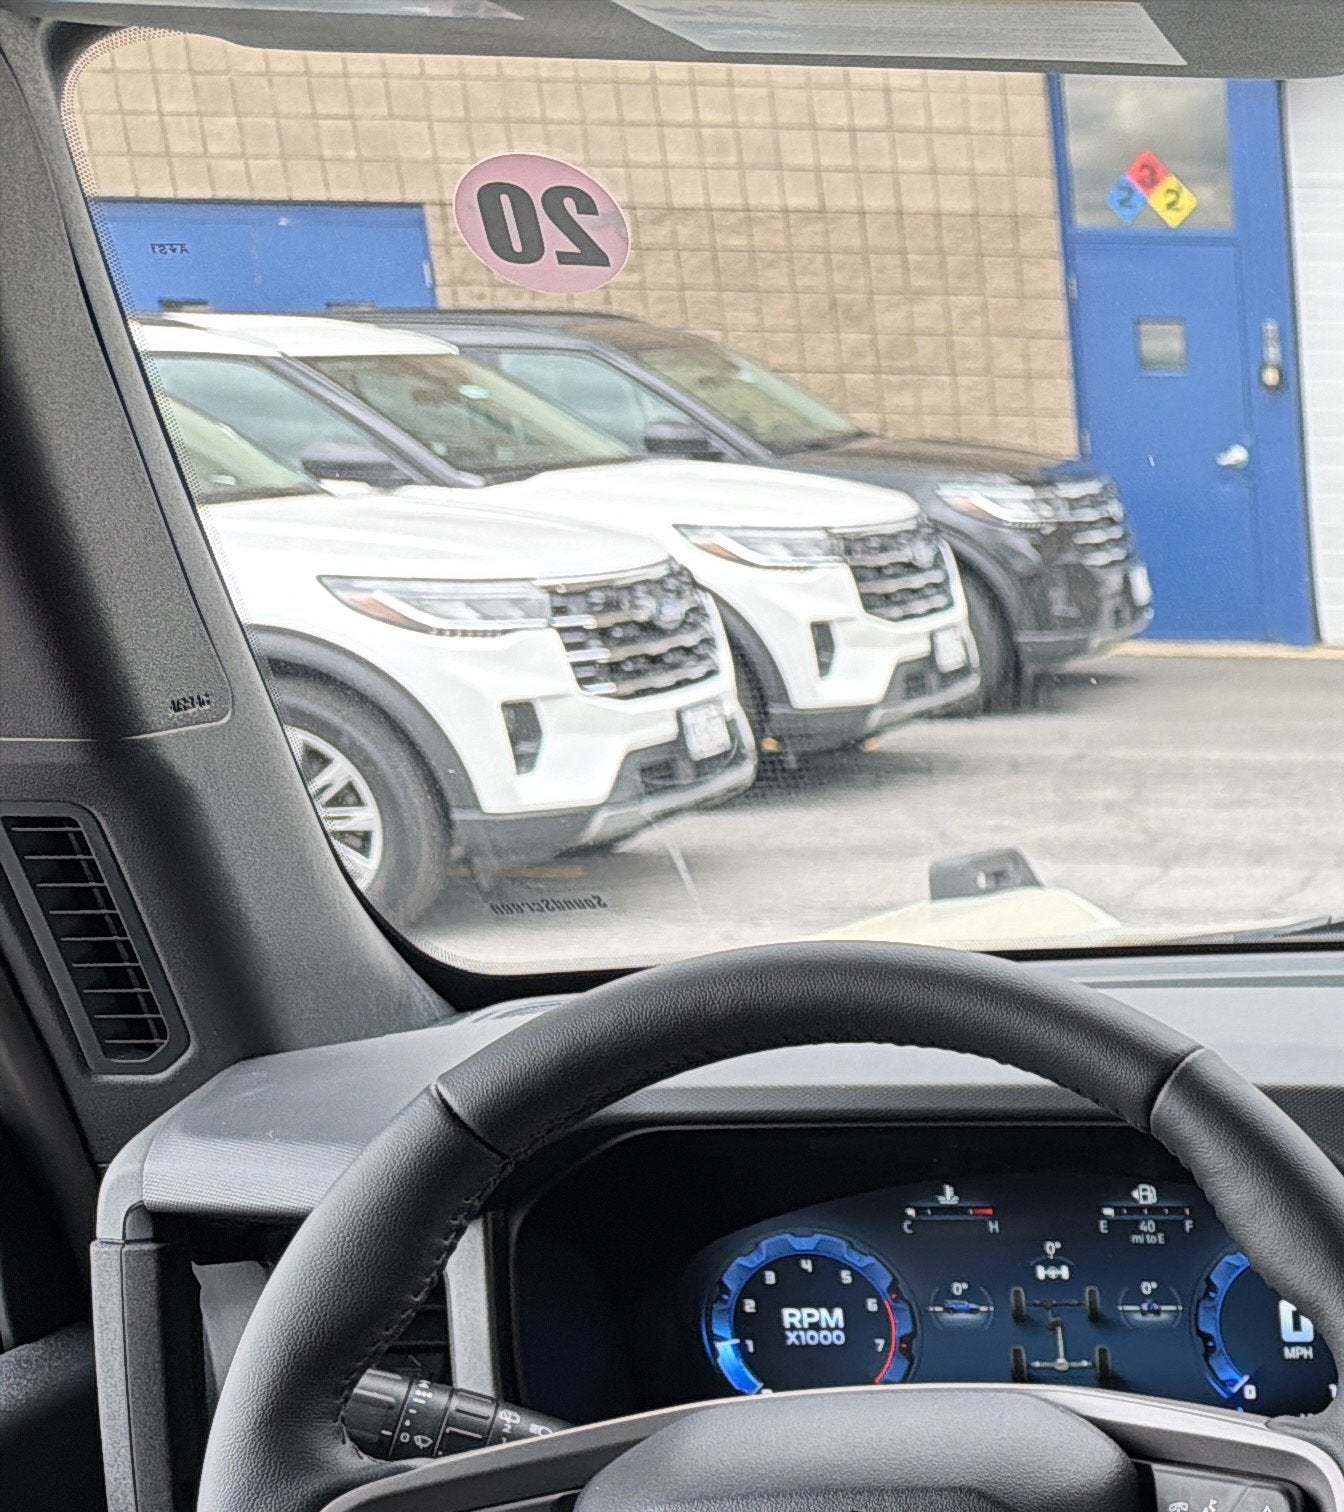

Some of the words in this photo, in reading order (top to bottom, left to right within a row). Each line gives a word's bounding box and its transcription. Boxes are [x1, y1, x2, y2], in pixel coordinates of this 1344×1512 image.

[1165, 188, 1180, 211] 2
[903, 1220, 913, 1234] C
[988, 1220, 1000, 1234] H
[1100, 1220, 1109, 1234] E
[1138, 1219, 1156, 1233] 40
[1184, 1220, 1194, 1234] F
[800, 1259, 813, 1273] 4
[840, 1270, 853, 1284] 5
[743, 1298, 756, 1313] 2
[781, 1308, 845, 1329] RPM
[785, 1330, 846, 1346] X1000
[875, 1338, 885, 1352] 7
[745, 1340, 754, 1353] 1
[1283, 1345, 1314, 1360] MPH
[1243, 1384, 1257, 1400] 0
